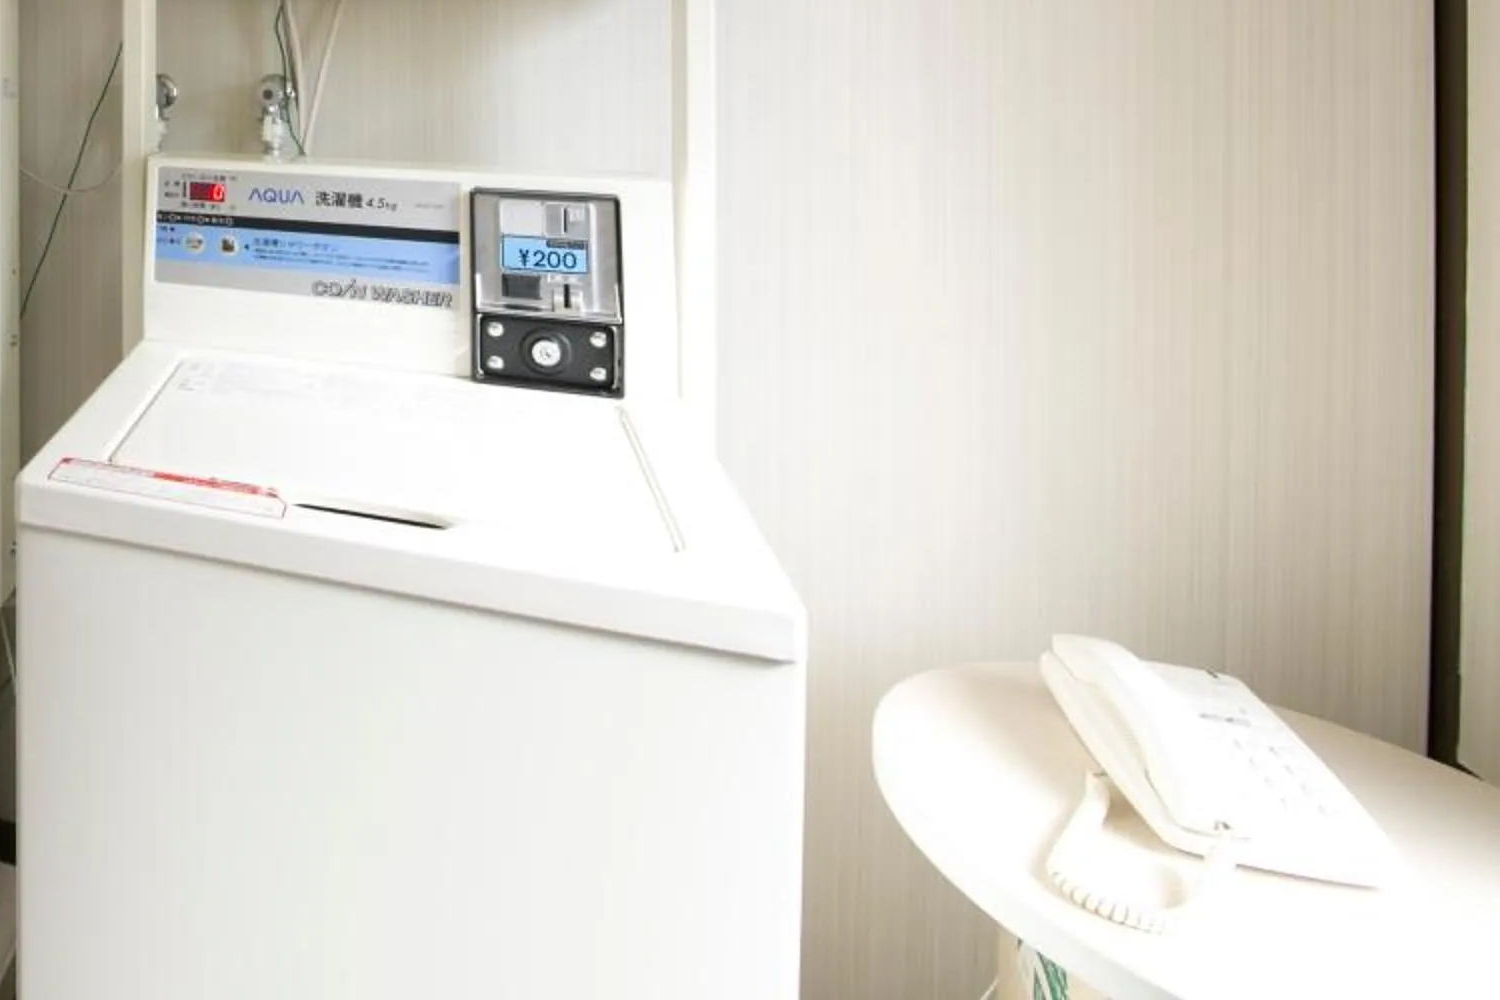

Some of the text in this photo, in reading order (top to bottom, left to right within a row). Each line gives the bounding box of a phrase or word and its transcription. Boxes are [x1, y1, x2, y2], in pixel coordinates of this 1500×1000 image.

[212, 183, 226, 201] 0
[248, 187, 305, 205] AQUA
[315, 190, 363, 208] 洗濯機
[518, 248, 578, 270] ¥200
